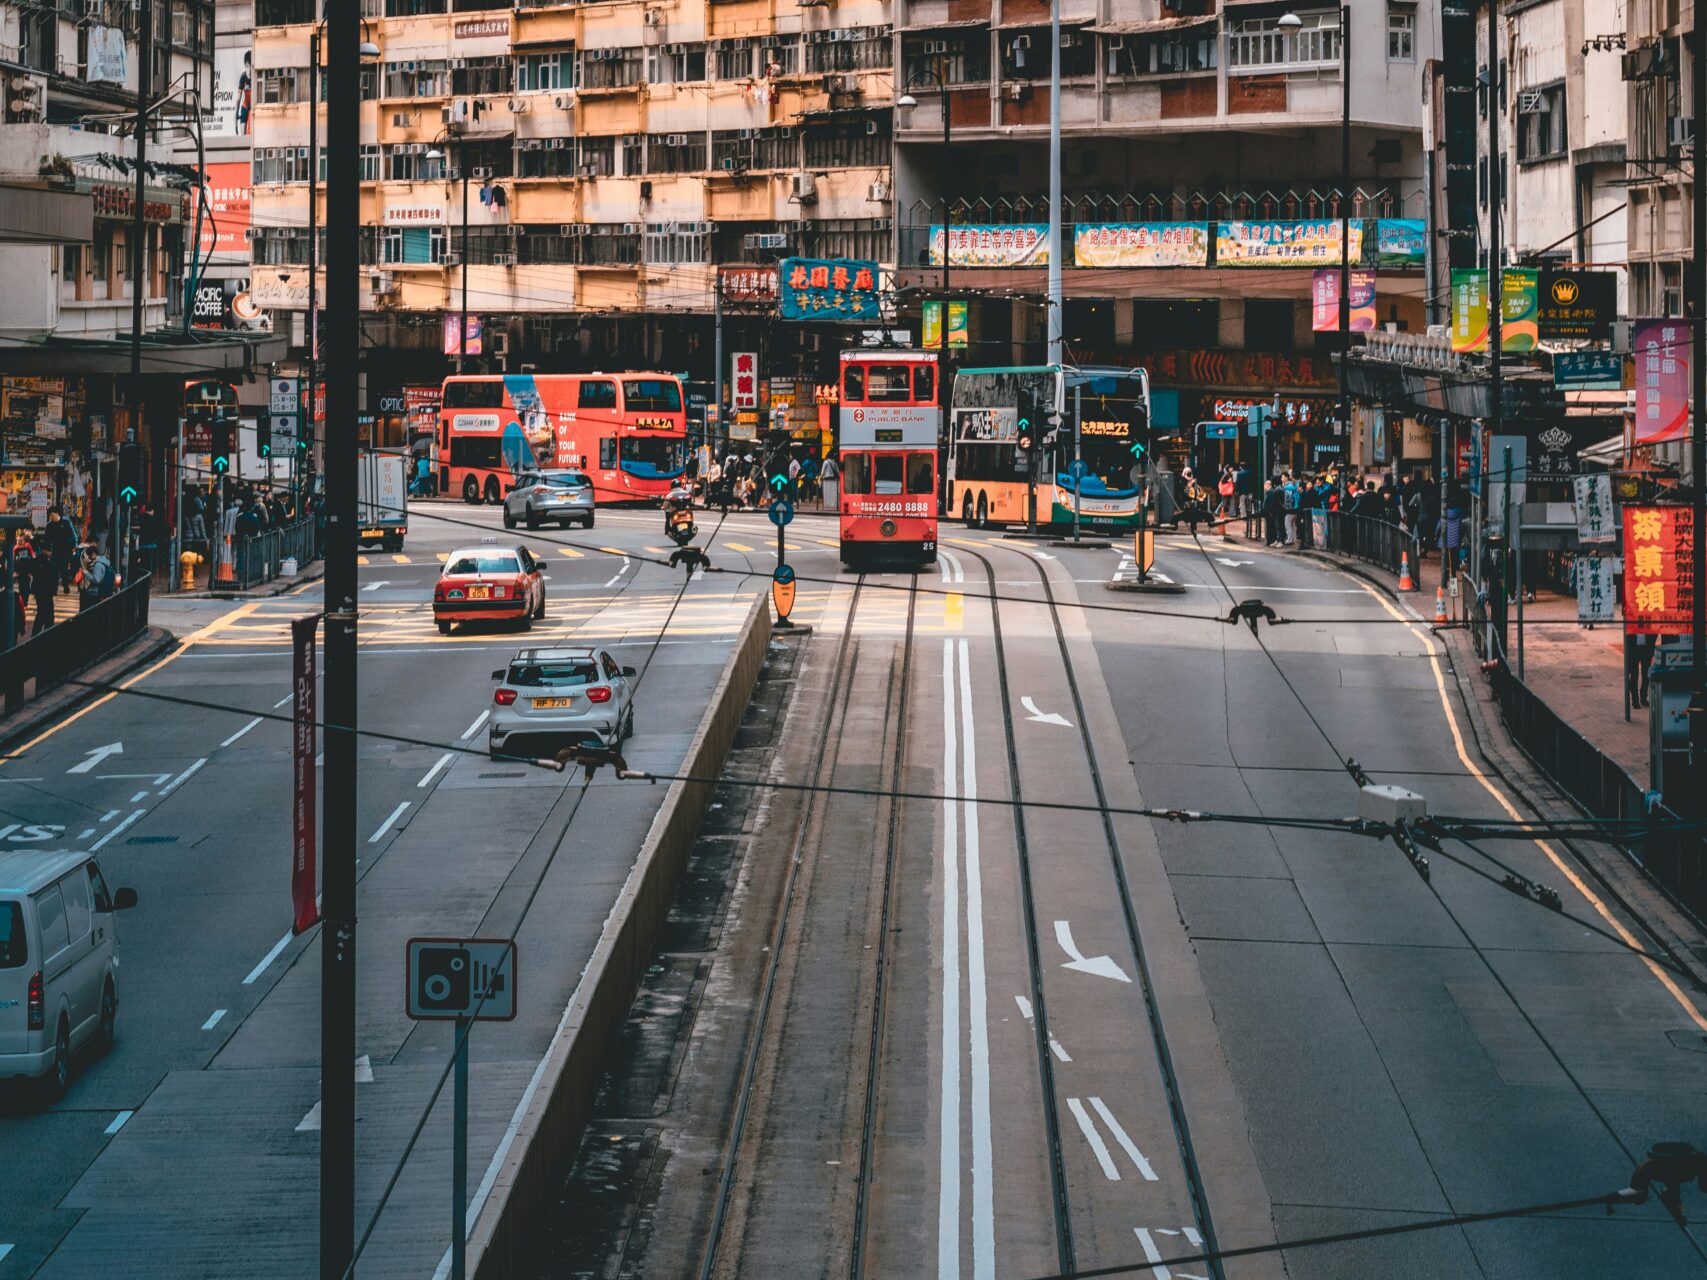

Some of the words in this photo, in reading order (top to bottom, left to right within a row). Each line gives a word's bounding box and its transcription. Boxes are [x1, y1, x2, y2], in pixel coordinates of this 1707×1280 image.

[936, 229, 1037, 249] 你們要靠主常常喜樂
[788, 265, 874, 290] 花園餐廳
[194, 302, 222, 316] COFFEE
[1662, 327, 1676, 374] 第七屆
[1646, 341, 1659, 419] 全港運動會
[1215, 402, 1249, 417] Kowloo
[559, 412, 576, 421] BANK
[661, 418, 673, 429] 2A
[1114, 422, 1129, 435] 23
[559, 426, 568, 434] OF
[559, 441, 576, 450] YOUR
[558, 454, 580, 463] FUTURE
[878, 502, 902, 512] 2480
[905, 502, 929, 512] 8888
[923, 542, 934, 550] 25
[552, 699, 567, 707] 770
